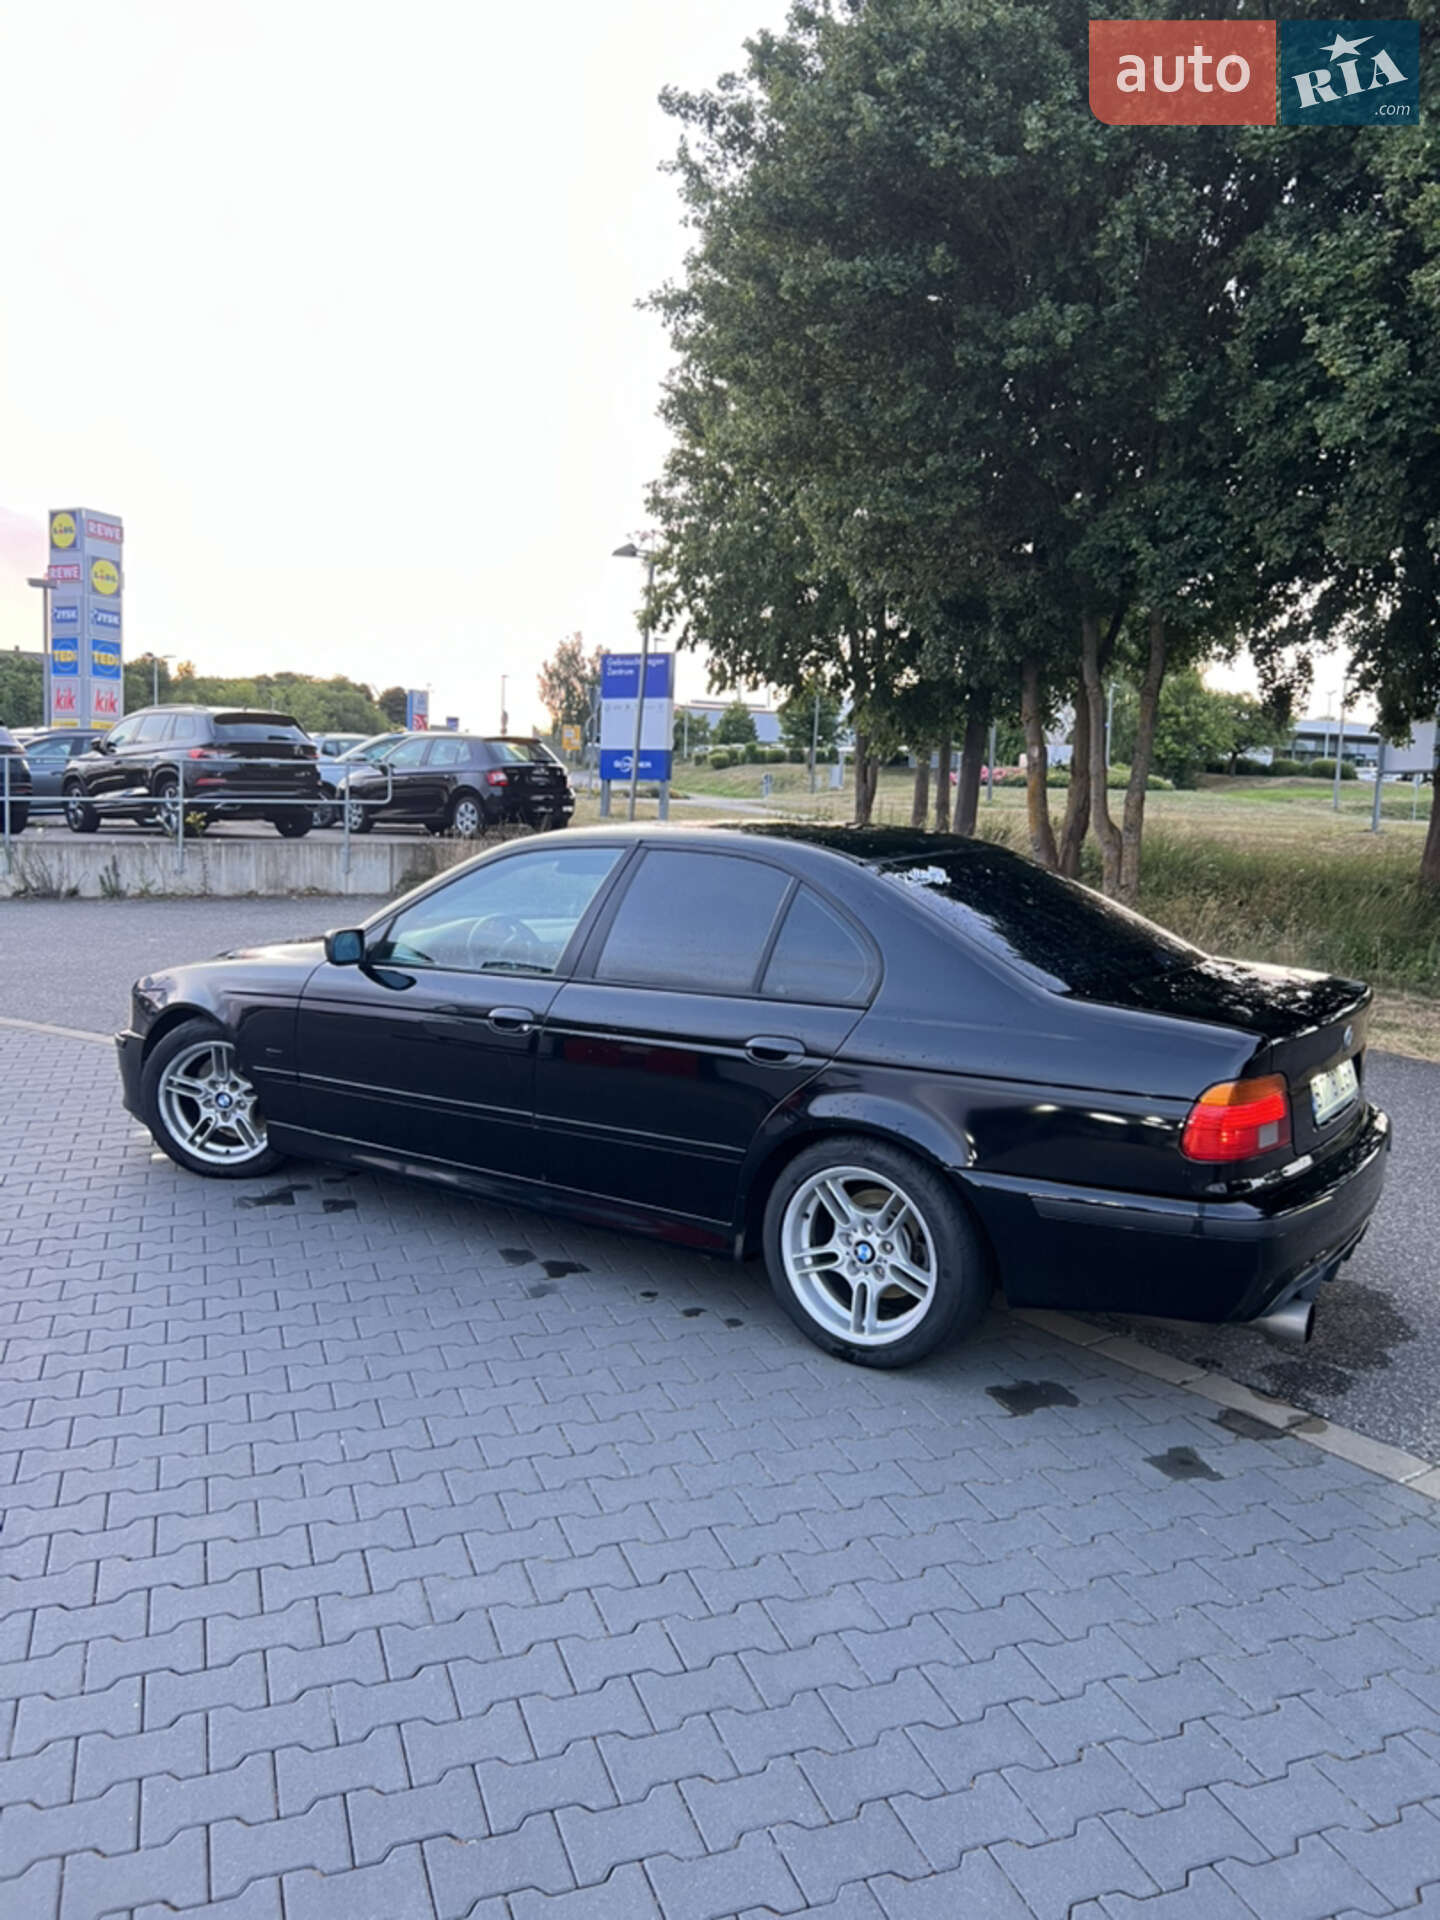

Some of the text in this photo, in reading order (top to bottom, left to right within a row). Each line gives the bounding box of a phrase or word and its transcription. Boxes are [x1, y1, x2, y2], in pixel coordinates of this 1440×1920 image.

[88, 520, 121, 540] REWE
[48, 565, 80, 580] REWE
[55, 608, 78, 620] JYSK
[97, 611, 120, 625] JYSK
